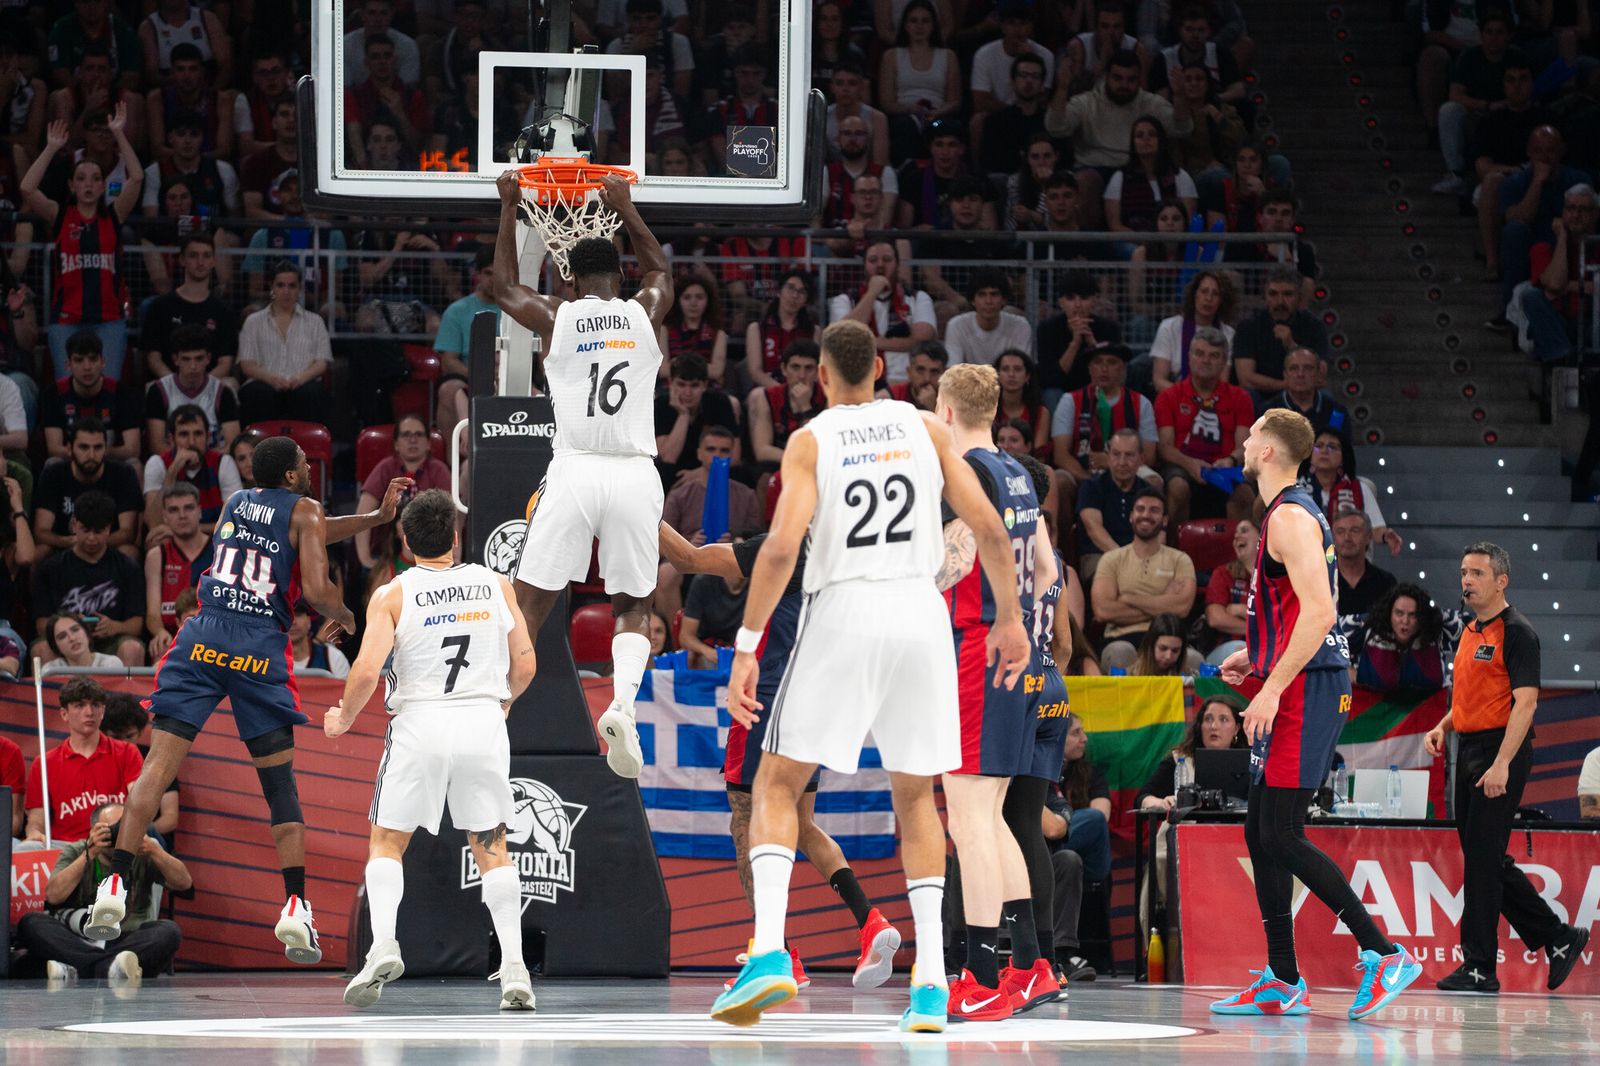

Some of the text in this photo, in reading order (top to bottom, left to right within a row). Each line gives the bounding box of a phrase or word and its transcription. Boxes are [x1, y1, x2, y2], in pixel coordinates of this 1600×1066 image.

[576, 315, 631, 333] GARUBA
[576, 340, 636, 353] AUTOHERO
[587, 360, 630, 417] 16
[482, 422, 555, 438] SPALDING
[838, 423, 906, 446] TAVARES
[842, 449, 911, 467] AUTOHERO
[844, 473, 916, 549] 22
[415, 585, 492, 607] CAMPAZZO
[424, 611, 490, 627] AUTOHERO
[190, 643, 270, 675] Recalvi
[441, 634, 471, 694] 7
